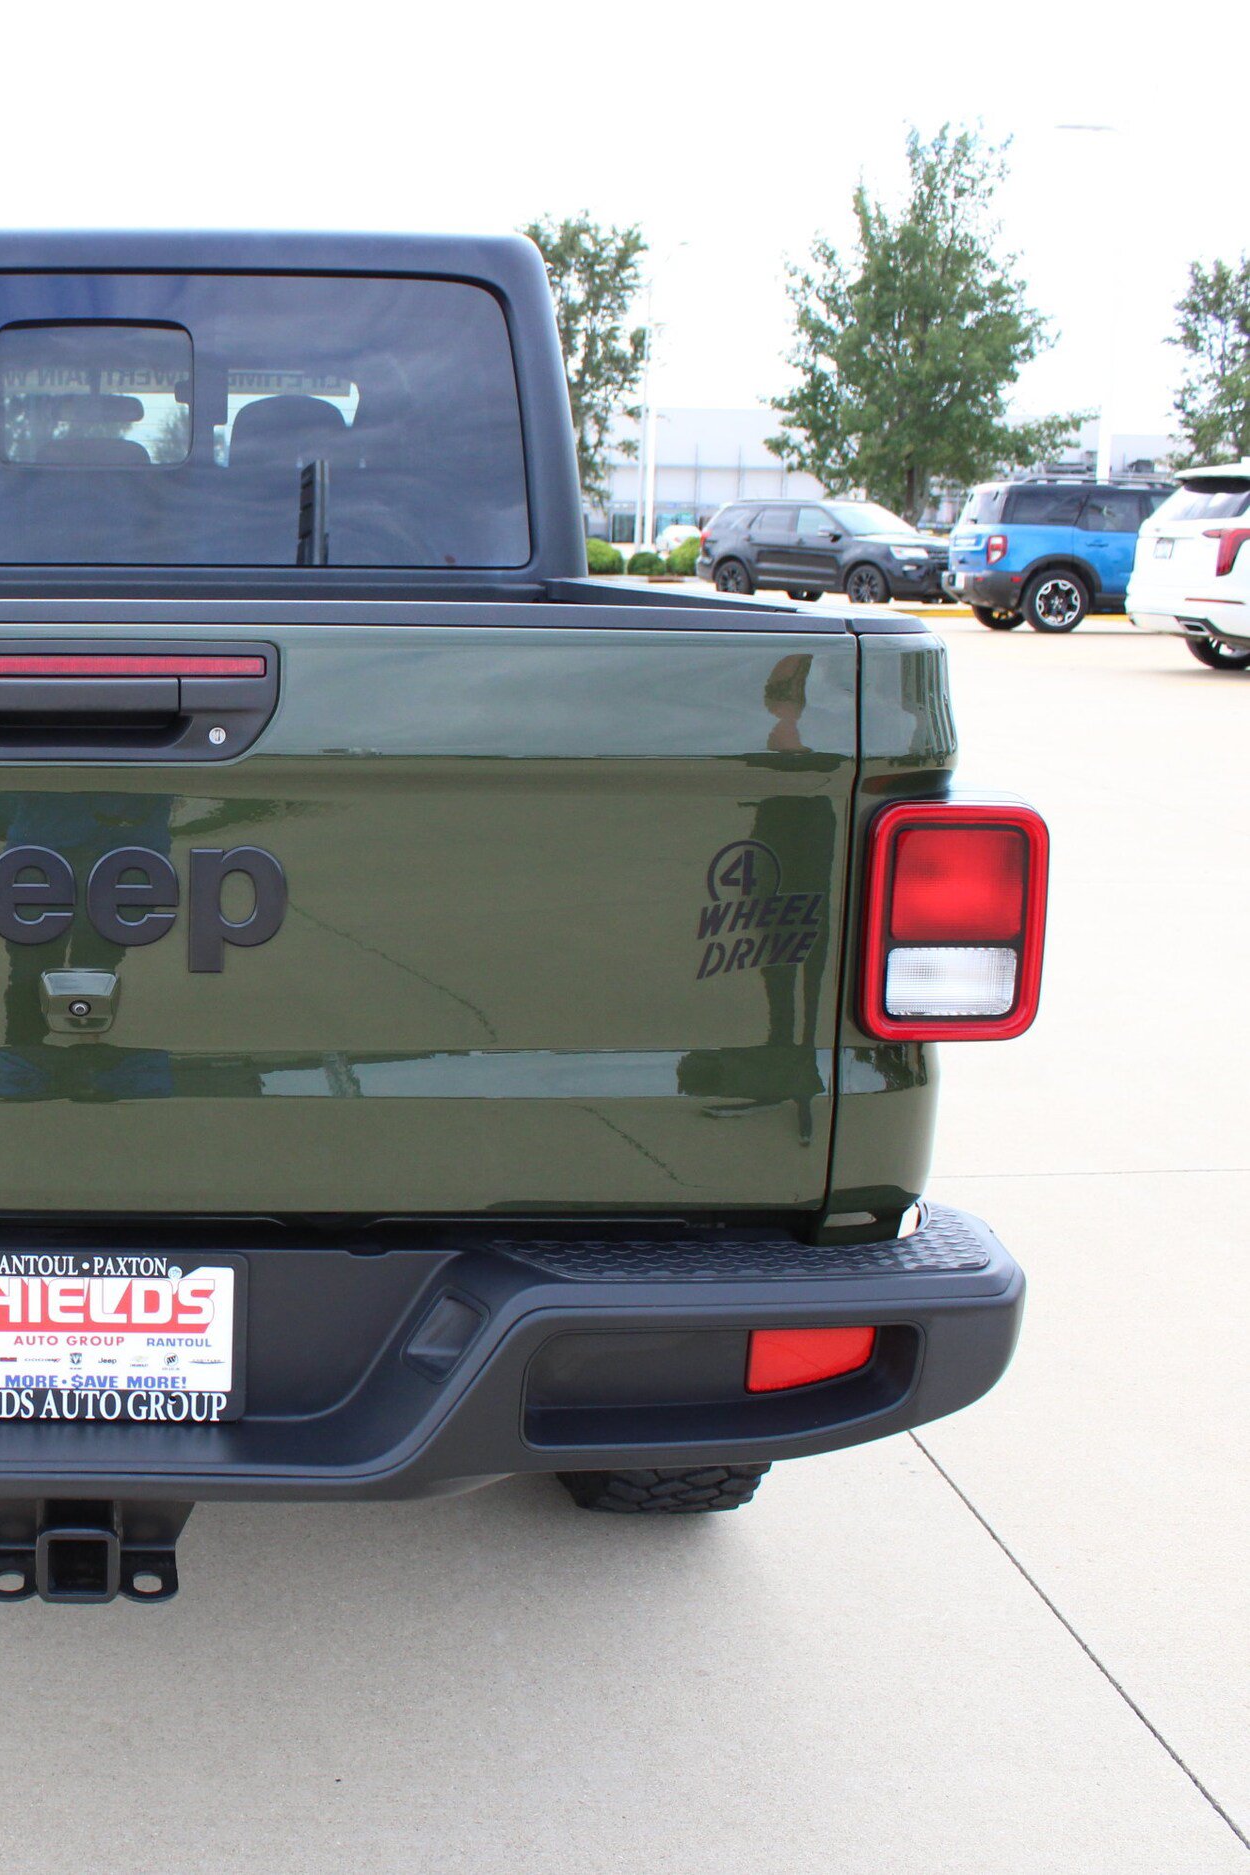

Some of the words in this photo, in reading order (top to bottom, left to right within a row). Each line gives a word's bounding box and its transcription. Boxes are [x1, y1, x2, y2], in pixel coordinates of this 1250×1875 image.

[720, 850, 757, 896] 4
[697, 894, 824, 940] WHEEL
[696, 931, 819, 980] DRIVE
[93, 1256, 168, 1277] PAXTON
[14, 1335, 59, 1346] AUTO
[66, 1335, 125, 1347] GROUP
[146, 1337, 212, 1348] RANTOUL
[98, 1357, 117, 1365] Jeep
[5, 1375, 59, 1388] MORE
[71, 1374, 119, 1389] $AVE
[127, 1376, 187, 1389] MORE!
[39, 1388, 122, 1420] AUTO
[127, 1390, 227, 1422] GROUP
